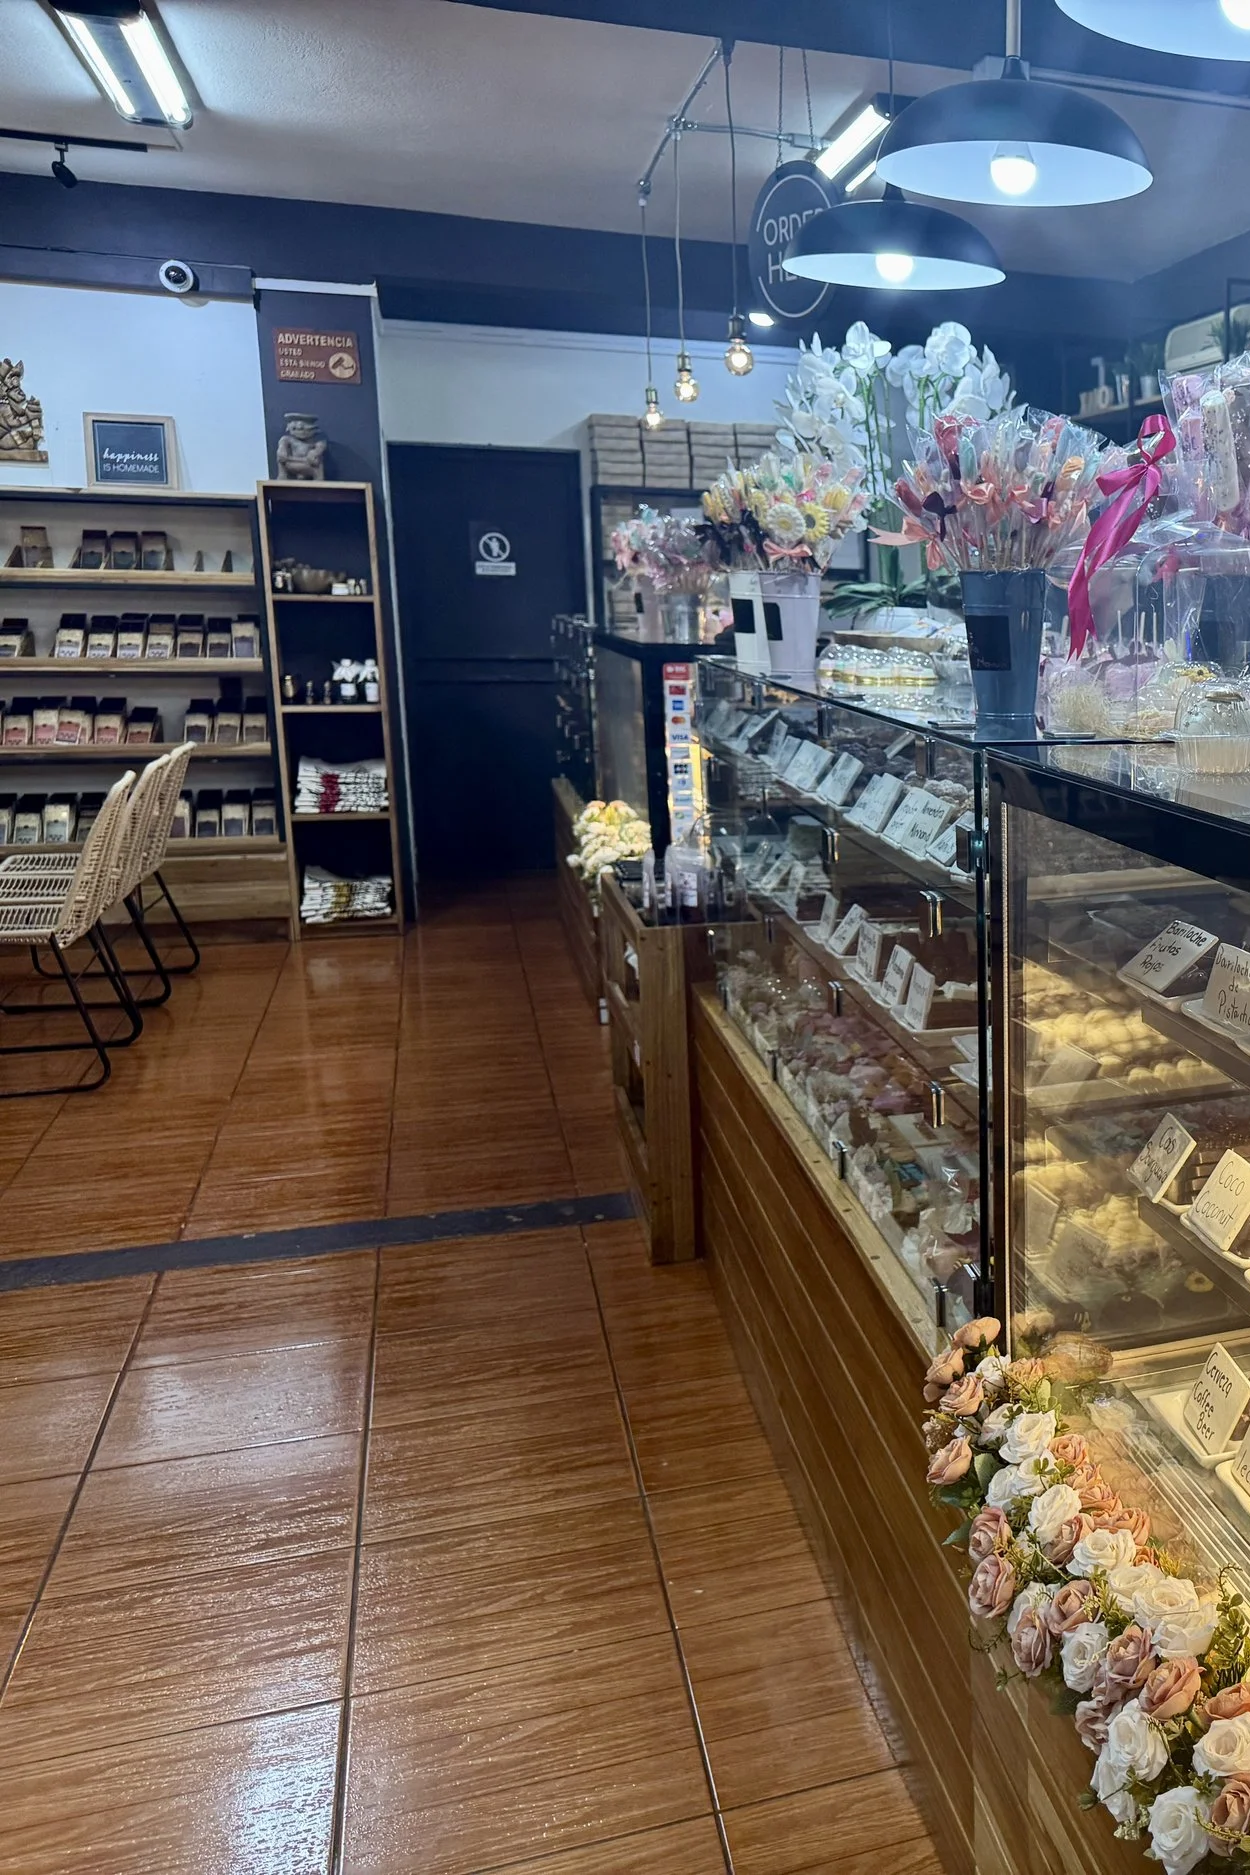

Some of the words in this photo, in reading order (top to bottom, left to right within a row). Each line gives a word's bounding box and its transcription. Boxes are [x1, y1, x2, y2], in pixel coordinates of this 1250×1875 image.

[277, 333, 353, 348] ADVERTENCIA
[103, 447, 159, 463] happiness
[103, 463, 111, 472] IS
[113, 463, 160, 473] HOMEMADE
[1166, 922, 1208, 947] Bariloche
[1228, 976, 1239, 993] de
[1158, 1126, 1177, 1155] Cas
[1219, 1161, 1246, 1197] Coco
[1195, 1191, 1239, 1229] Coconut
[1196, 1411, 1215, 1440] Beer
